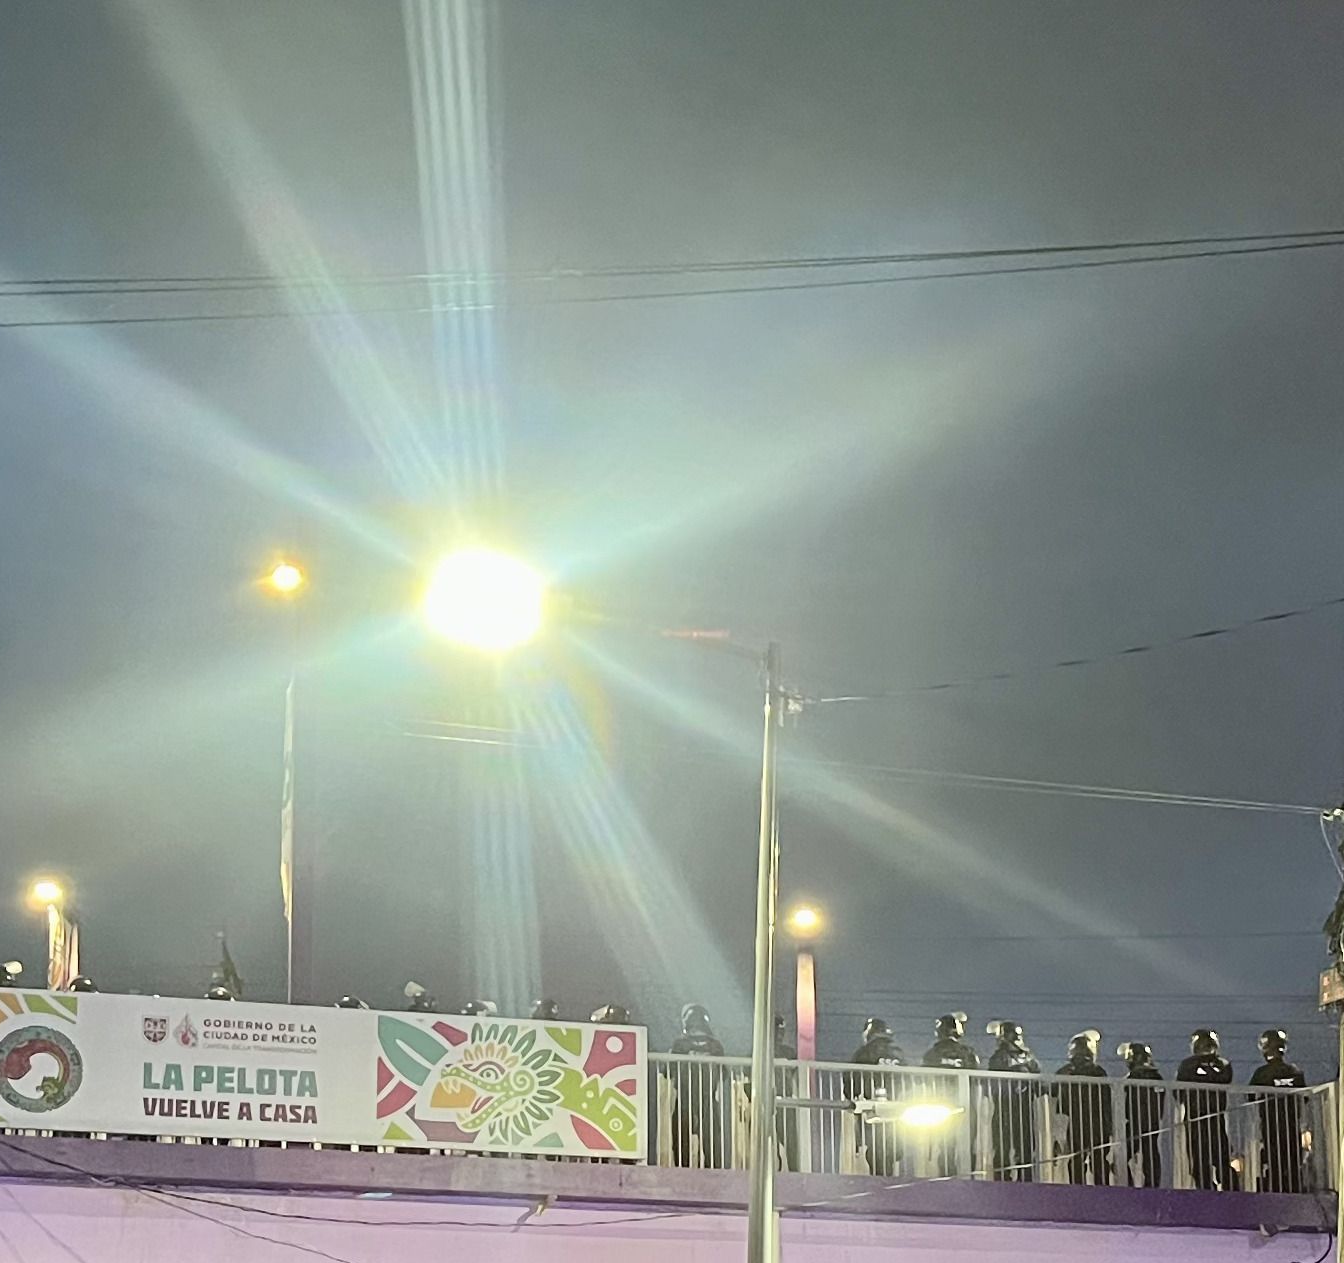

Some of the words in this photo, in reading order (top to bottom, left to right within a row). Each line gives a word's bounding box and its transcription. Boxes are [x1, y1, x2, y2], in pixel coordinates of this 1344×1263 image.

[203, 1018, 273, 1031] GOBIERNO
[278, 1022, 295, 1032] DE
[300, 1023, 317, 1033] LA
[203, 1030, 249, 1041] CIUDAD
[252, 1032, 268, 1042] DE
[271, 1033, 317, 1045] MÉXICO
[143, 1061, 184, 1091] LA
[193, 1065, 318, 1098] PELOTA
[143, 1097, 230, 1120] VUELVE
[237, 1102, 253, 1121] A
[259, 1103, 318, 1124] CASA
